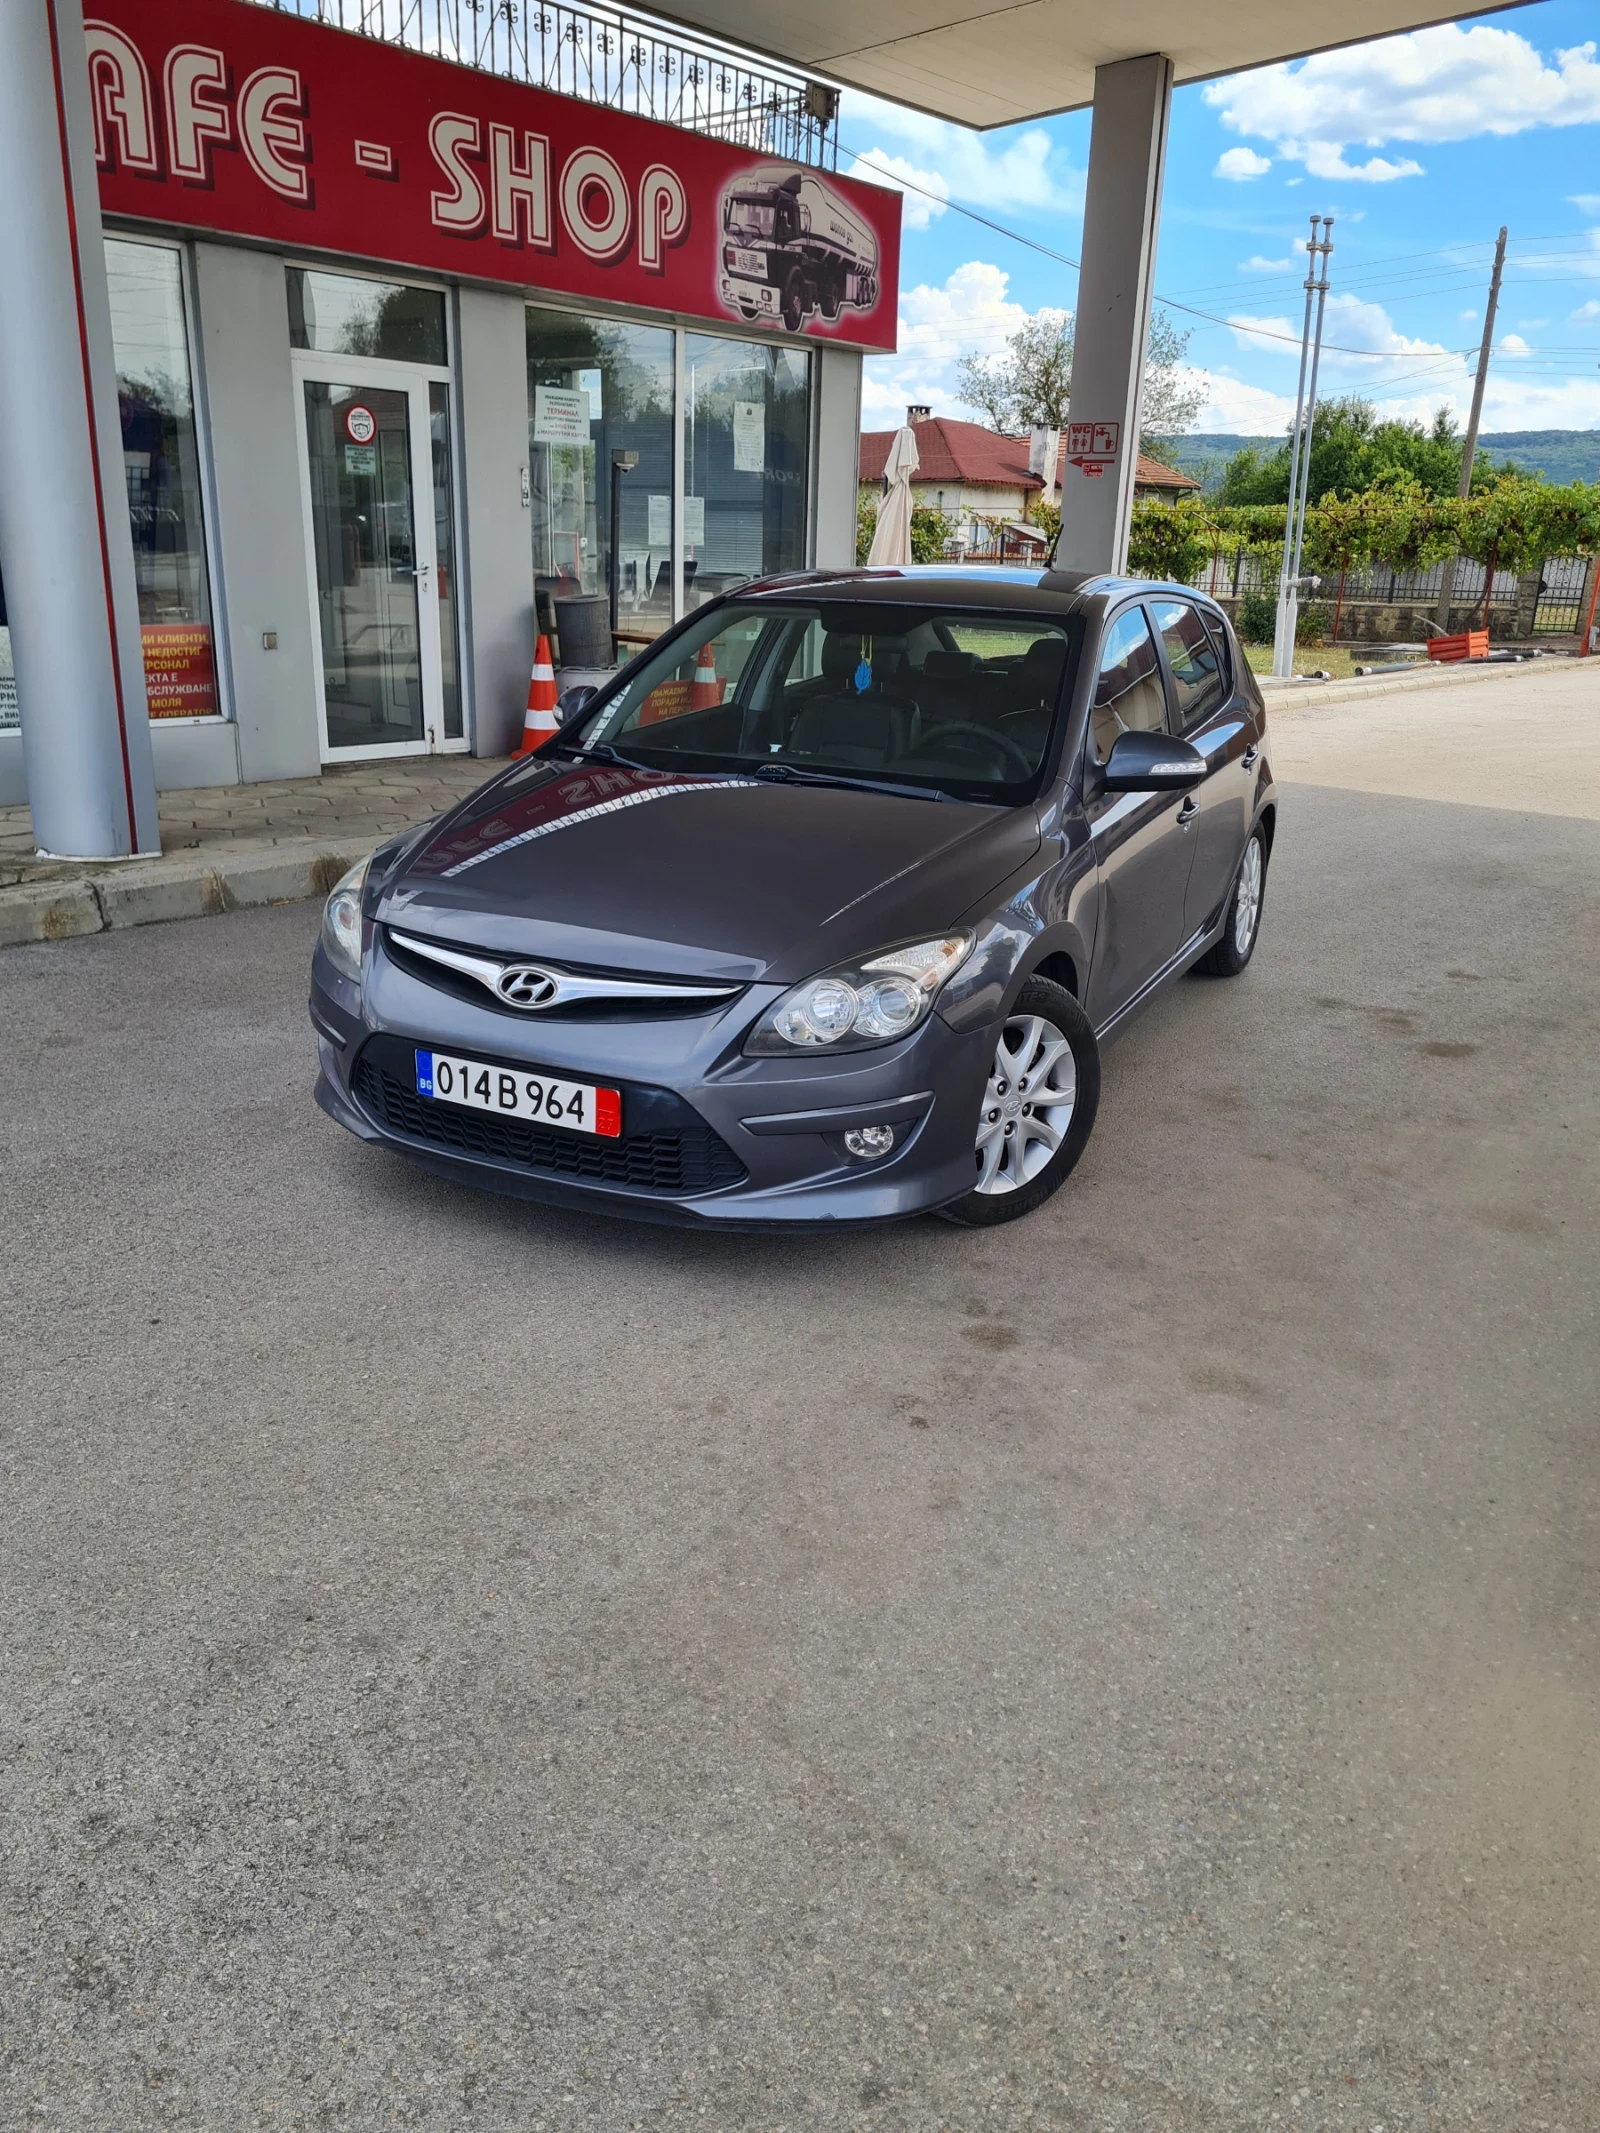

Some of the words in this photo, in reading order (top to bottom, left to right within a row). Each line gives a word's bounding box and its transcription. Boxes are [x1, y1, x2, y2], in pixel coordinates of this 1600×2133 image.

[83, 18, 310, 204] AFE
[428, 111, 690, 272] SHOP
[547, 408, 579, 417] ТЕРМИНАЛ
[1072, 426, 1090, 434] WC
[148, 646, 202, 658] НЕДОСТИГ
[144, 659, 190, 671] РСОНАЛ
[171, 672, 178, 682] Е
[147, 683, 213, 696] БСЛУЖВАНЕ
[151, 698, 182, 708] МОЛЯ
[420, 1078, 432, 1090] BG
